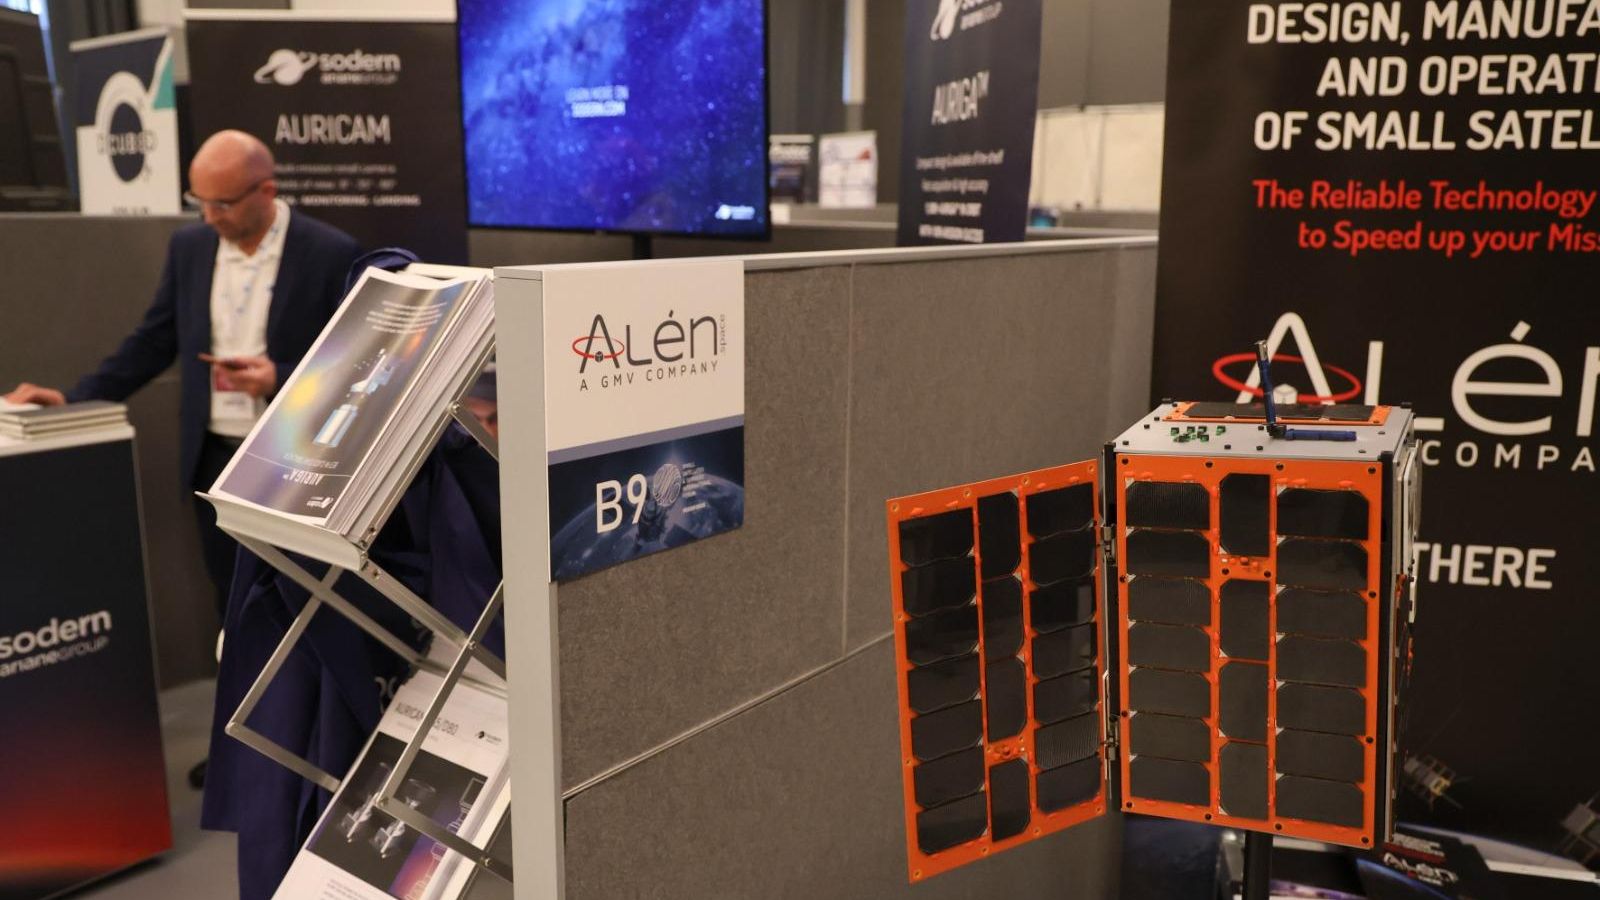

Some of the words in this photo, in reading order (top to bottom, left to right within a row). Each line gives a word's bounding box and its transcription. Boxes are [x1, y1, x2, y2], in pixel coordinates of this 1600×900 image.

[1247, 2, 1410, 46] DESIGN,
[319, 49, 400, 72] sodern
[1316, 56, 1408, 97] AND
[275, 114, 391, 144] AURICAM
[1254, 111, 1309, 151] OF
[1315, 110, 1457, 151] SMALL
[1252, 179, 1304, 209] The
[1310, 179, 1422, 210] Reliable
[1429, 179, 1597, 219] Technology
[1297, 220, 1327, 249] to
[1332, 219, 1423, 258] Speed
[1428, 229, 1466, 259] up
[1470, 230, 1540, 259] your
[579, 379, 588, 391] A
[601, 373, 634, 388] GMV
[645, 360, 718, 382] COMPANY
[1421, 440, 1596, 473] COMPA
[595, 473, 647, 534] B9
[0, 610, 111, 659] sodern
